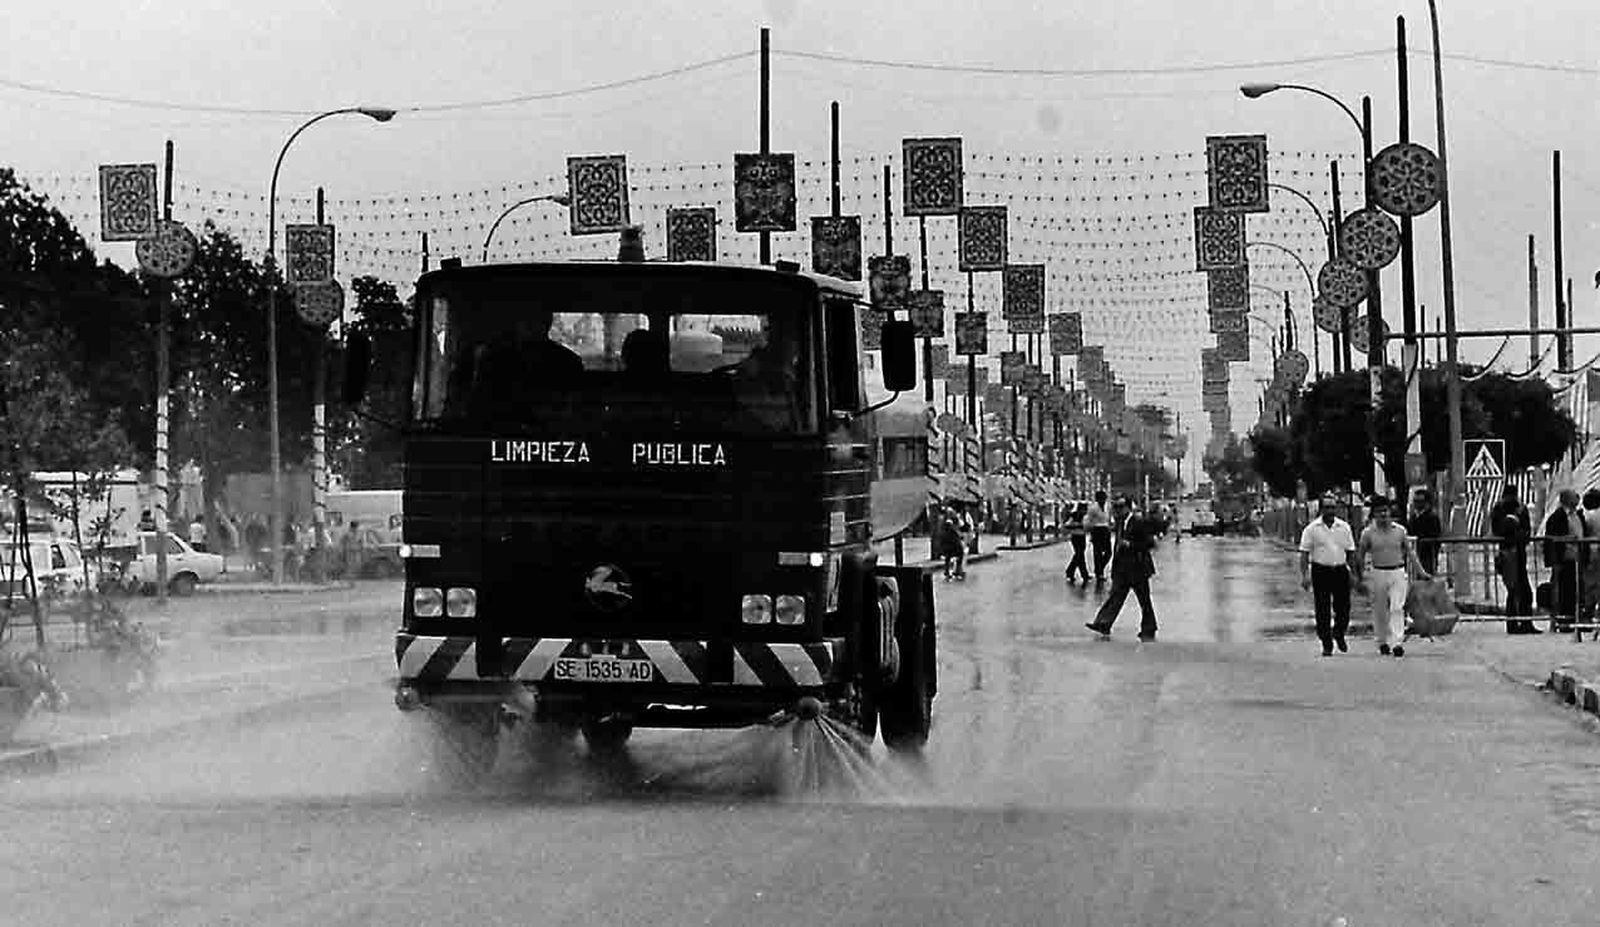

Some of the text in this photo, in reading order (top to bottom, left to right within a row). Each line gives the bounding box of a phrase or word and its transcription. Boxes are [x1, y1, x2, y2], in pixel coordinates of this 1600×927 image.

[491, 440, 726, 465] LIMPIEZA PUBLICA
[629, 661, 651, 680] AD
